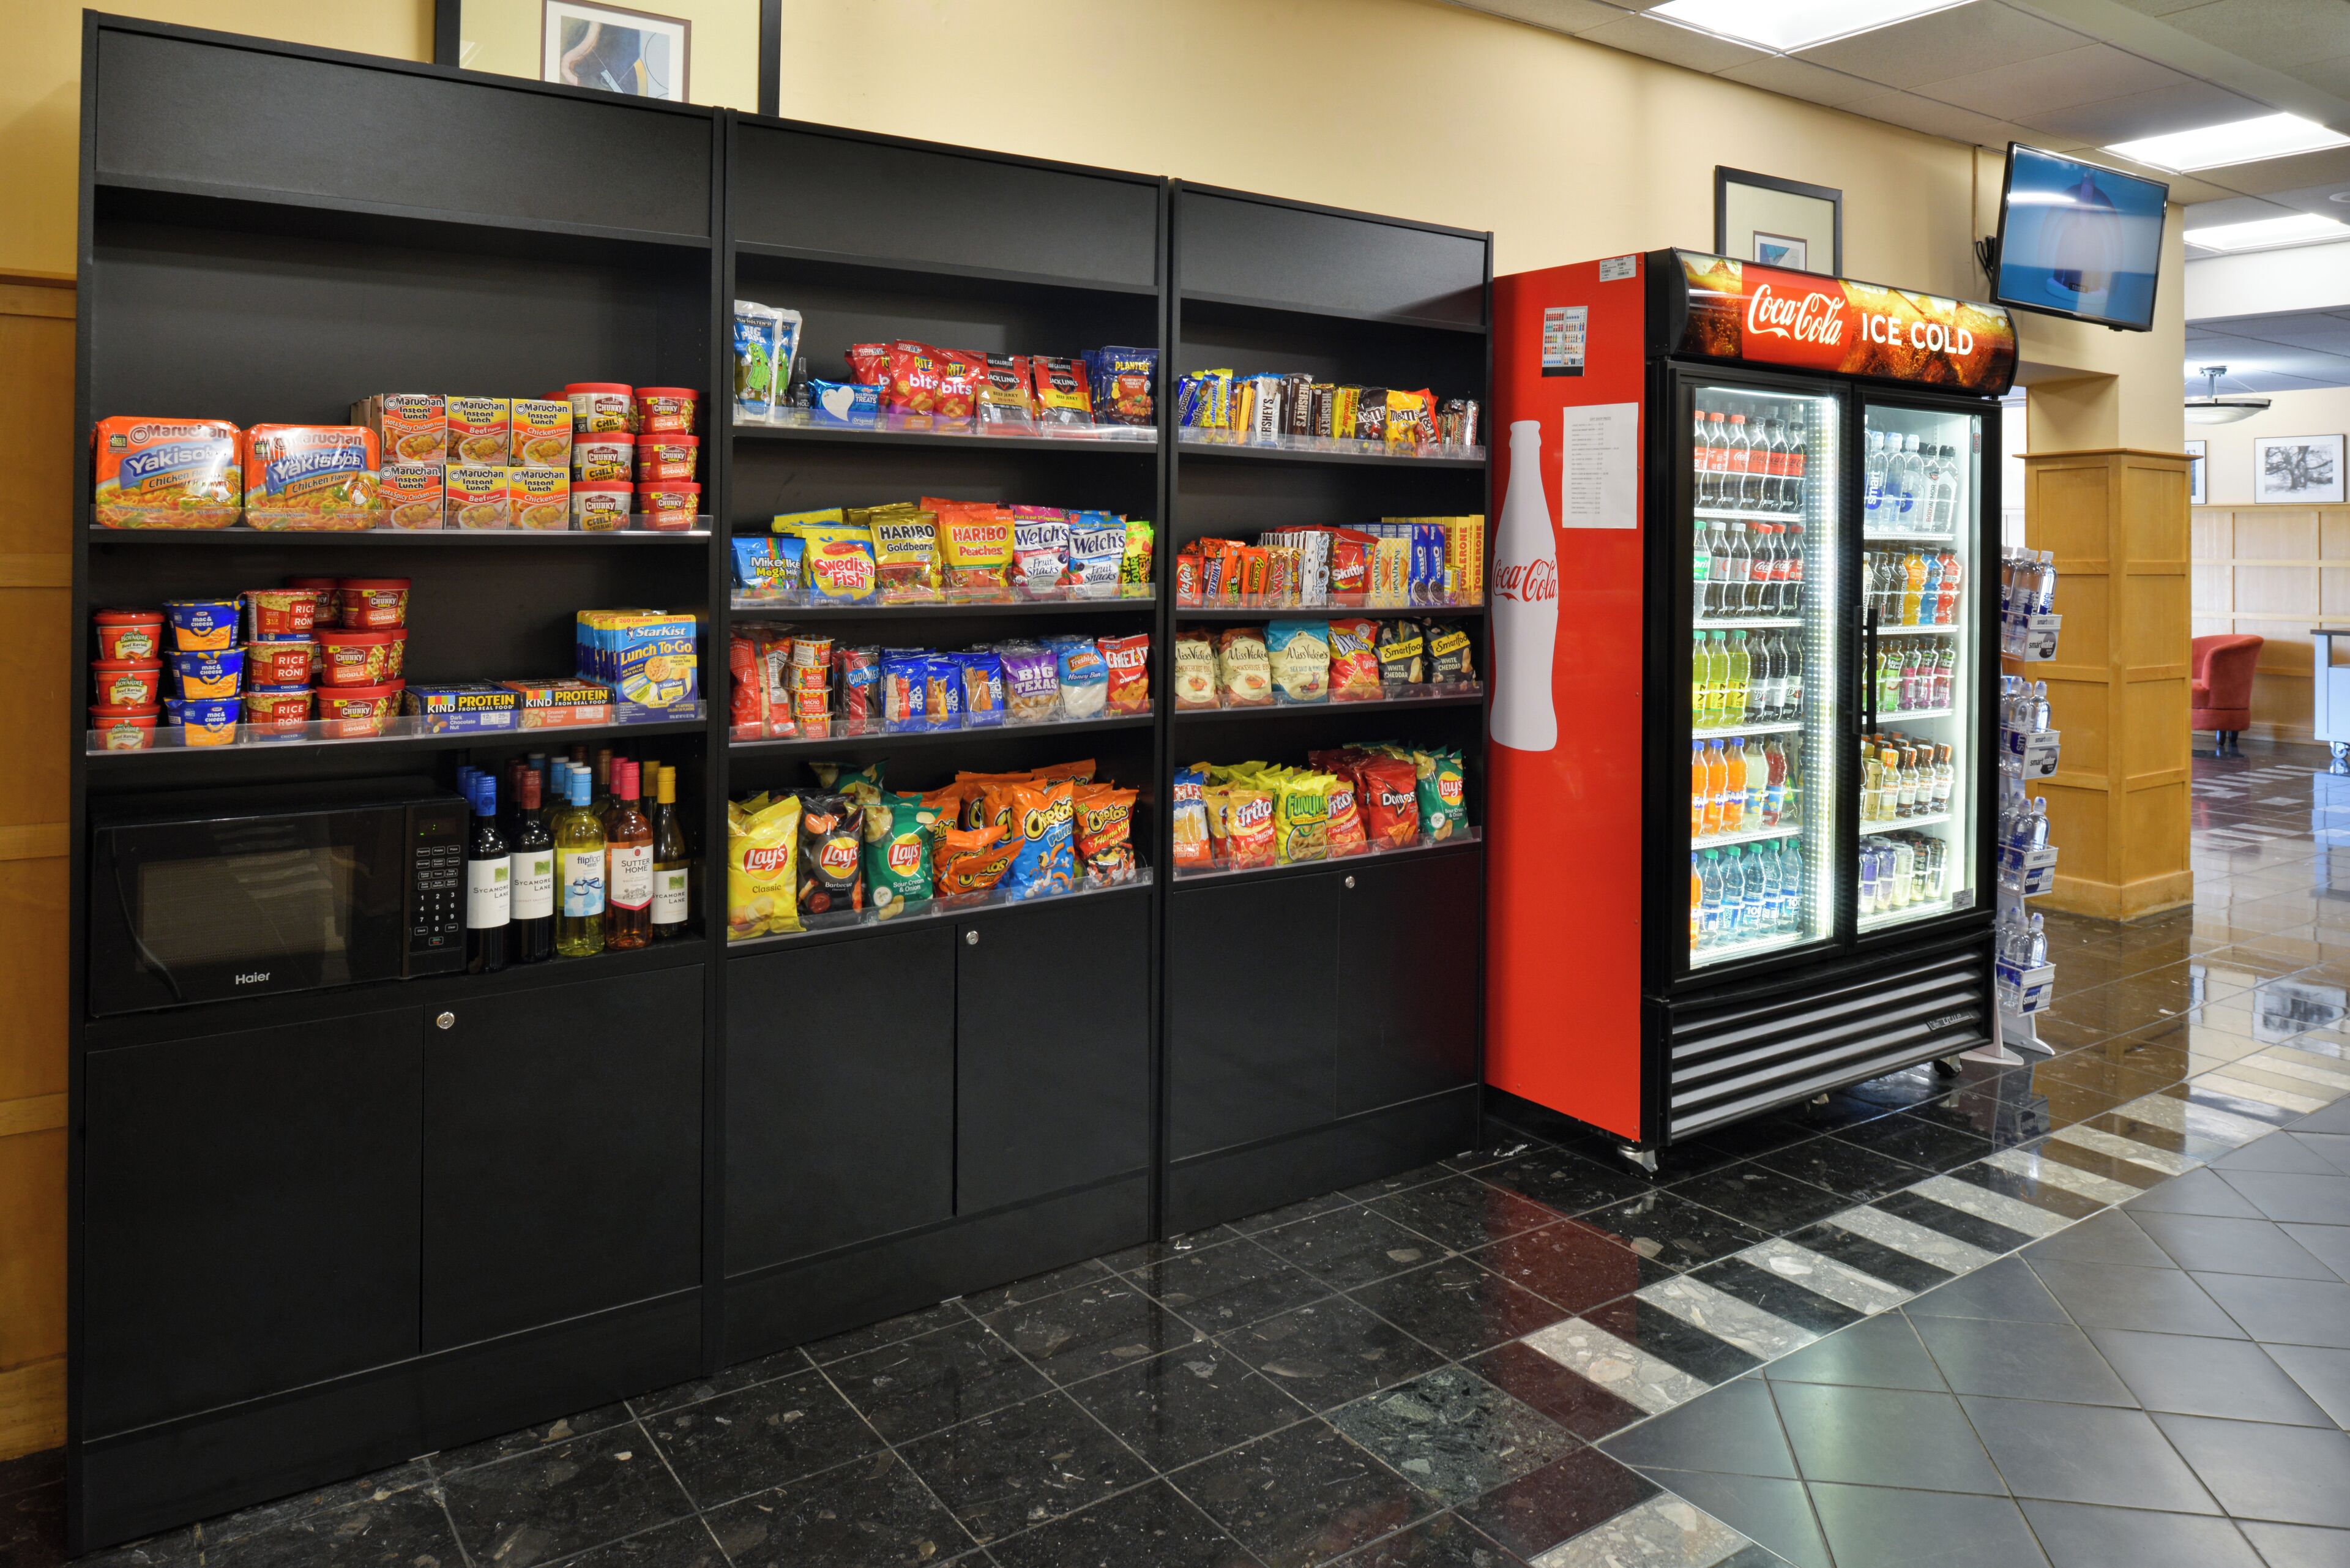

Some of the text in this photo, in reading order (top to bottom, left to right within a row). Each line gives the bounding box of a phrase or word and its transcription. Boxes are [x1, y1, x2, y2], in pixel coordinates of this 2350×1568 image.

[1748, 283, 1845, 345] Coca-Cola
[744, 326, 761, 336] BIG
[1862, 313, 1974, 355] ICE COLD
[741, 331, 766, 344] PAPA
[914, 356, 934, 370] RITZ
[1115, 361, 1149, 371] PLANTERS
[947, 364, 966, 377] RITZ
[909, 374, 939, 389] bits
[987, 373, 1020, 383] JACK LINK'S
[1049, 378, 1078, 387] JACK LINK'S
[941, 382, 972, 395] bits
[397, 397, 443, 407] Maruchan
[460, 401, 505, 411] Maruchan
[1296, 383, 1310, 427] HERSHEY'S
[525, 403, 568, 413] Maruchan
[1262, 398, 1274, 441] HERSHEY'S
[413, 421, 435, 431] Chicken
[469, 426, 488, 435] Beef
[527, 427, 556, 436] Chicken
[589, 452, 617, 461] CHUNKY
[274, 452, 362, 480] Yakisoba
[392, 466, 439, 476] Maruchan
[460, 469, 504, 479] Maruchan
[521, 470, 565, 479] Maruchan
[589, 467, 615, 477] CHILI
[292, 472, 352, 494] Chicken Flavor
[408, 491, 430, 501] Chicken
[468, 495, 487, 503] Beef
[524, 494, 554, 503] Chicken
[587, 501, 615, 510] CHUNKY
[587, 517, 612, 527] CHILI
[879, 525, 935, 540] HARIBO
[952, 526, 1007, 542] HARIBO
[1015, 526, 1069, 545] Welch's
[887, 543, 933, 553] Goldbears
[1073, 534, 1125, 554] Welch's
[959, 545, 1004, 556] Peaches
[751, 556, 782, 567] Mike
[1032, 558, 1054, 568] Fruit
[756, 566, 785, 578] Mega
[814, 558, 874, 577] Swedish
[1026, 566, 1059, 578] Snacks
[832, 571, 865, 589] Fish
[1207, 561, 1221, 599] SNICKERS
[1493, 559, 1557, 602] Coca-Cola
[636, 625, 686, 637] StarKist
[621, 640, 693, 666] Lunch To-Go
[278, 656, 305, 665] RICE
[278, 668, 303, 677] RONI
[1018, 666, 1054, 681] BIG
[1015, 679, 1059, 693] TEXAS
[458, 694, 515, 707] PROTEIN
[555, 690, 608, 702] PROTEIN
[526, 699, 553, 707] KIND
[278, 705, 304, 714] RICE
[427, 704, 455, 714] KIND
[278, 717, 302, 726] RONI
[1440, 779, 1463, 797] Lay's
[1382, 791, 1416, 806] Doritos
[1023, 799, 1073, 841] Cheetos
[1087, 804, 1129, 833] Cheetos
[577, 856, 601, 865] flipflop
[746, 844, 786, 872] Lay's
[824, 842, 858, 868] Lay's
[890, 842, 920, 871] Lay's
[621, 858, 651, 867] SUTTER
[514, 878, 551, 886] SYCAMORE
[473, 884, 509, 894] SYCAMORE
[752, 883, 782, 894] Classic
[235, 971, 270, 985] Haier
